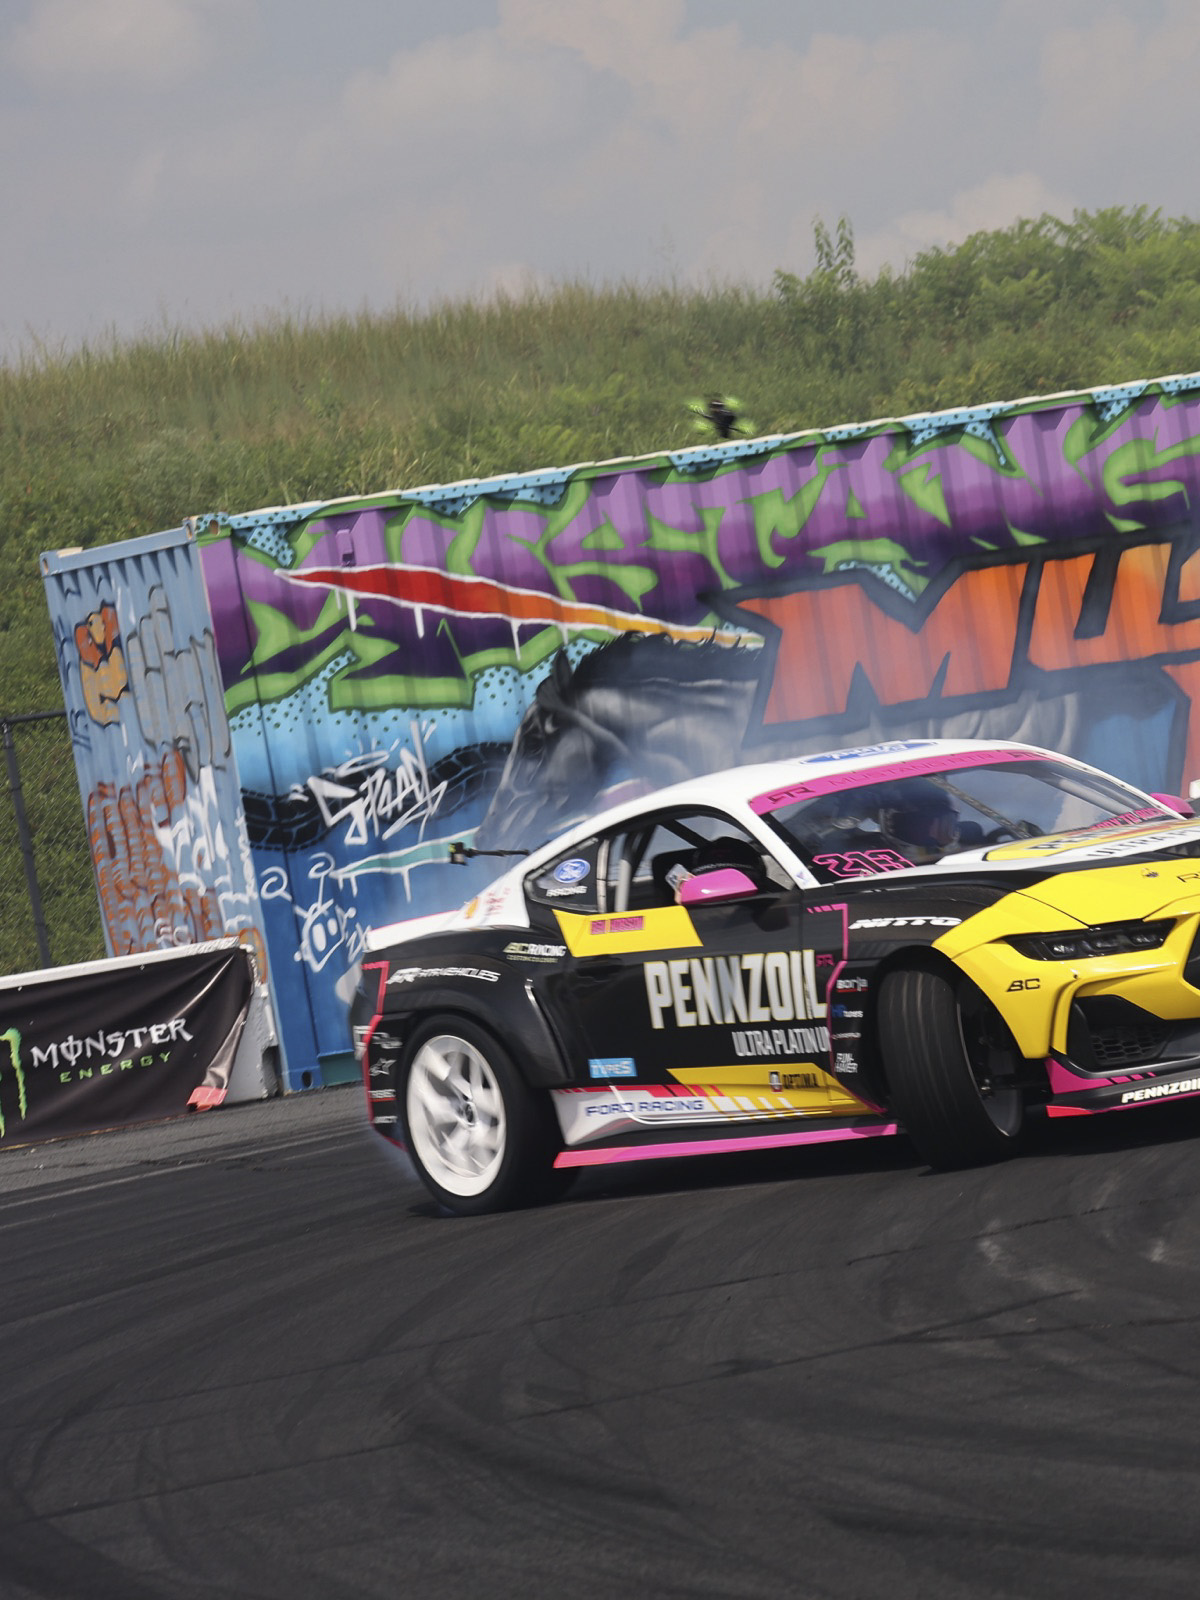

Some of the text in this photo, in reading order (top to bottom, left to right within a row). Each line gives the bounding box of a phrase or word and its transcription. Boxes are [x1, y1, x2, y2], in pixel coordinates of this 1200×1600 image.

[829, 759, 946, 787] MUSTANG
[848, 916, 963, 930] NITTO
[644, 949, 828, 1029] PENNZOIL
[30, 1017, 194, 1070] MONSTER
[732, 1026, 832, 1057] ULTRA PLATINU
[60, 1051, 171, 1083] ENERGY
[586, 1100, 704, 1117] FORD RACING
